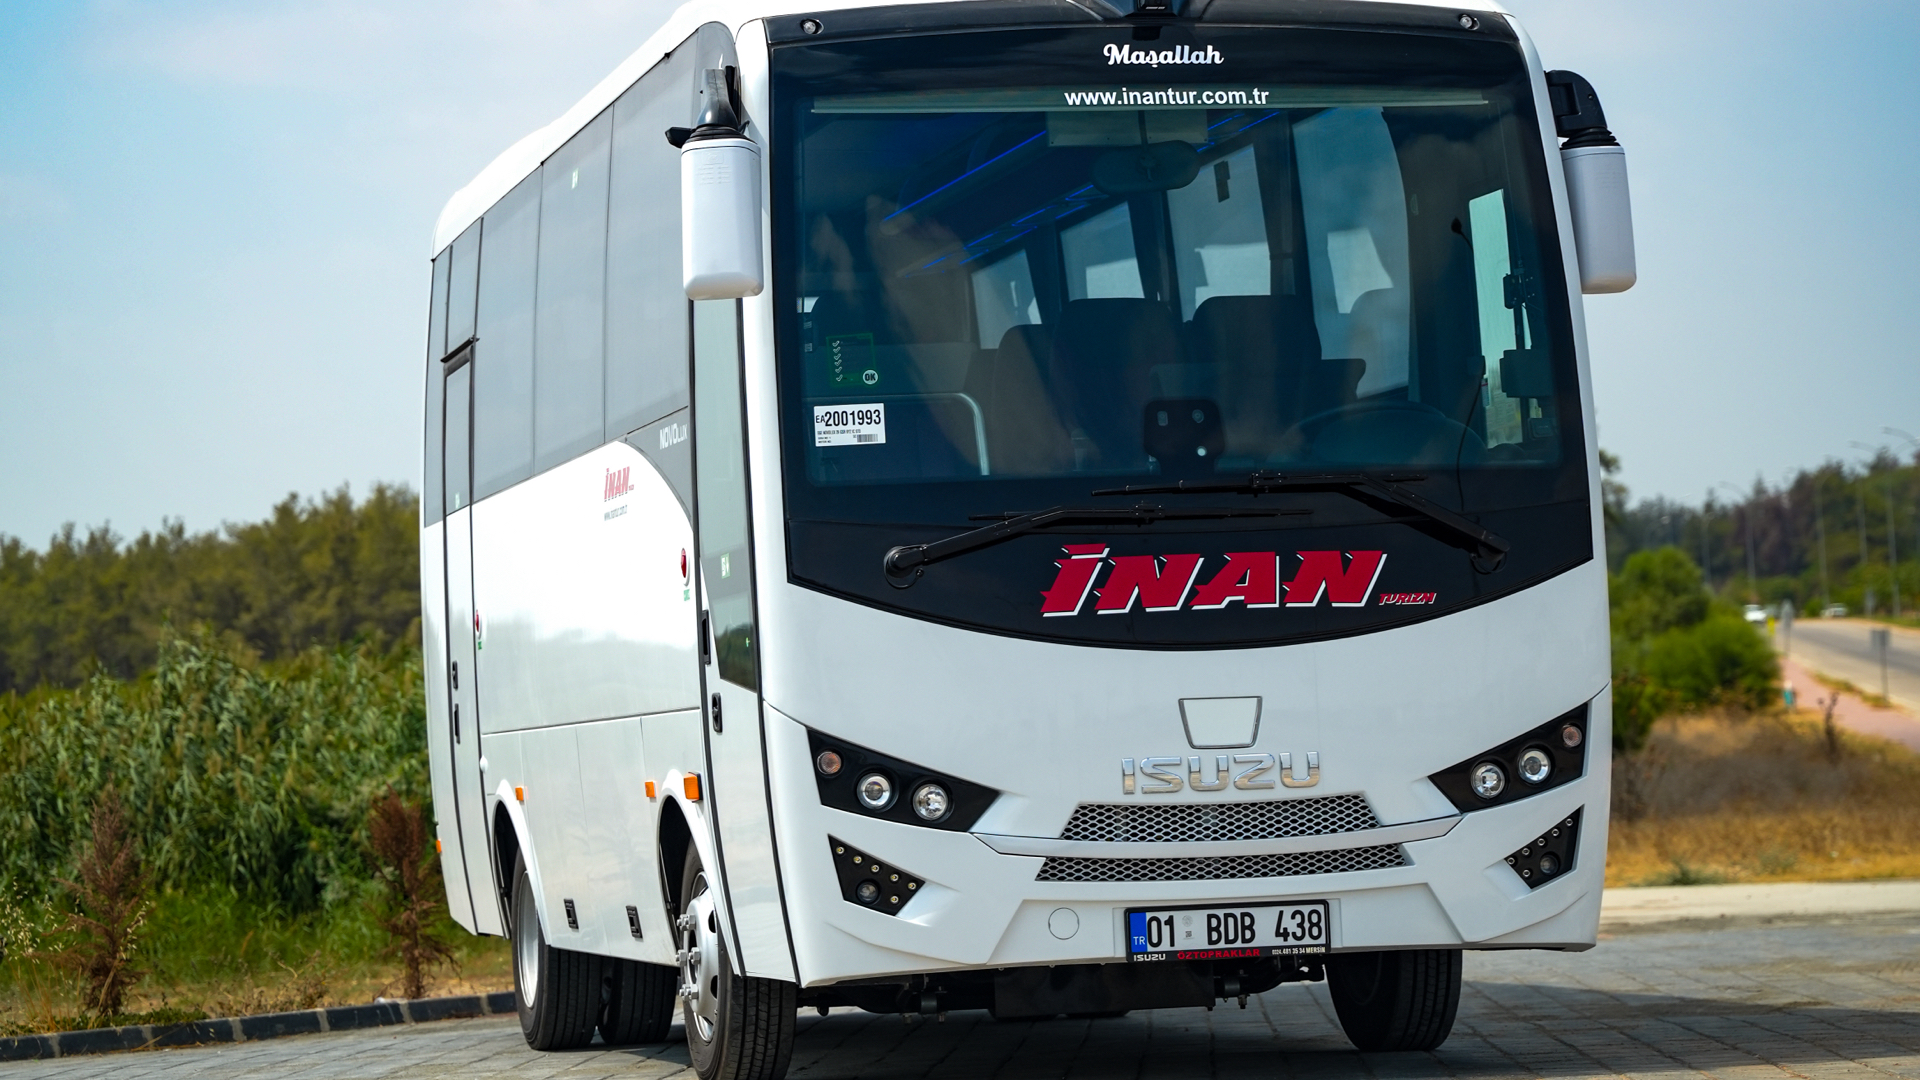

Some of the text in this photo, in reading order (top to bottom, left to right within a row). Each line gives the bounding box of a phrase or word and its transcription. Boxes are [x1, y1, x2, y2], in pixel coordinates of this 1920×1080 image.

[1103, 43, 1224, 68] Maşallah
[1064, 87, 1270, 106] www.inantur.com.tr
[864, 373, 876, 382] OK
[1039, 543, 1388, 617] İNAN
[1121, 751, 1321, 795] ISUZU
[1133, 909, 1323, 948] TR 01 BDB 438
[1133, 953, 1166, 962] ISUZU
[1177, 948, 1260, 960] ÖZTOPRAKLAR
